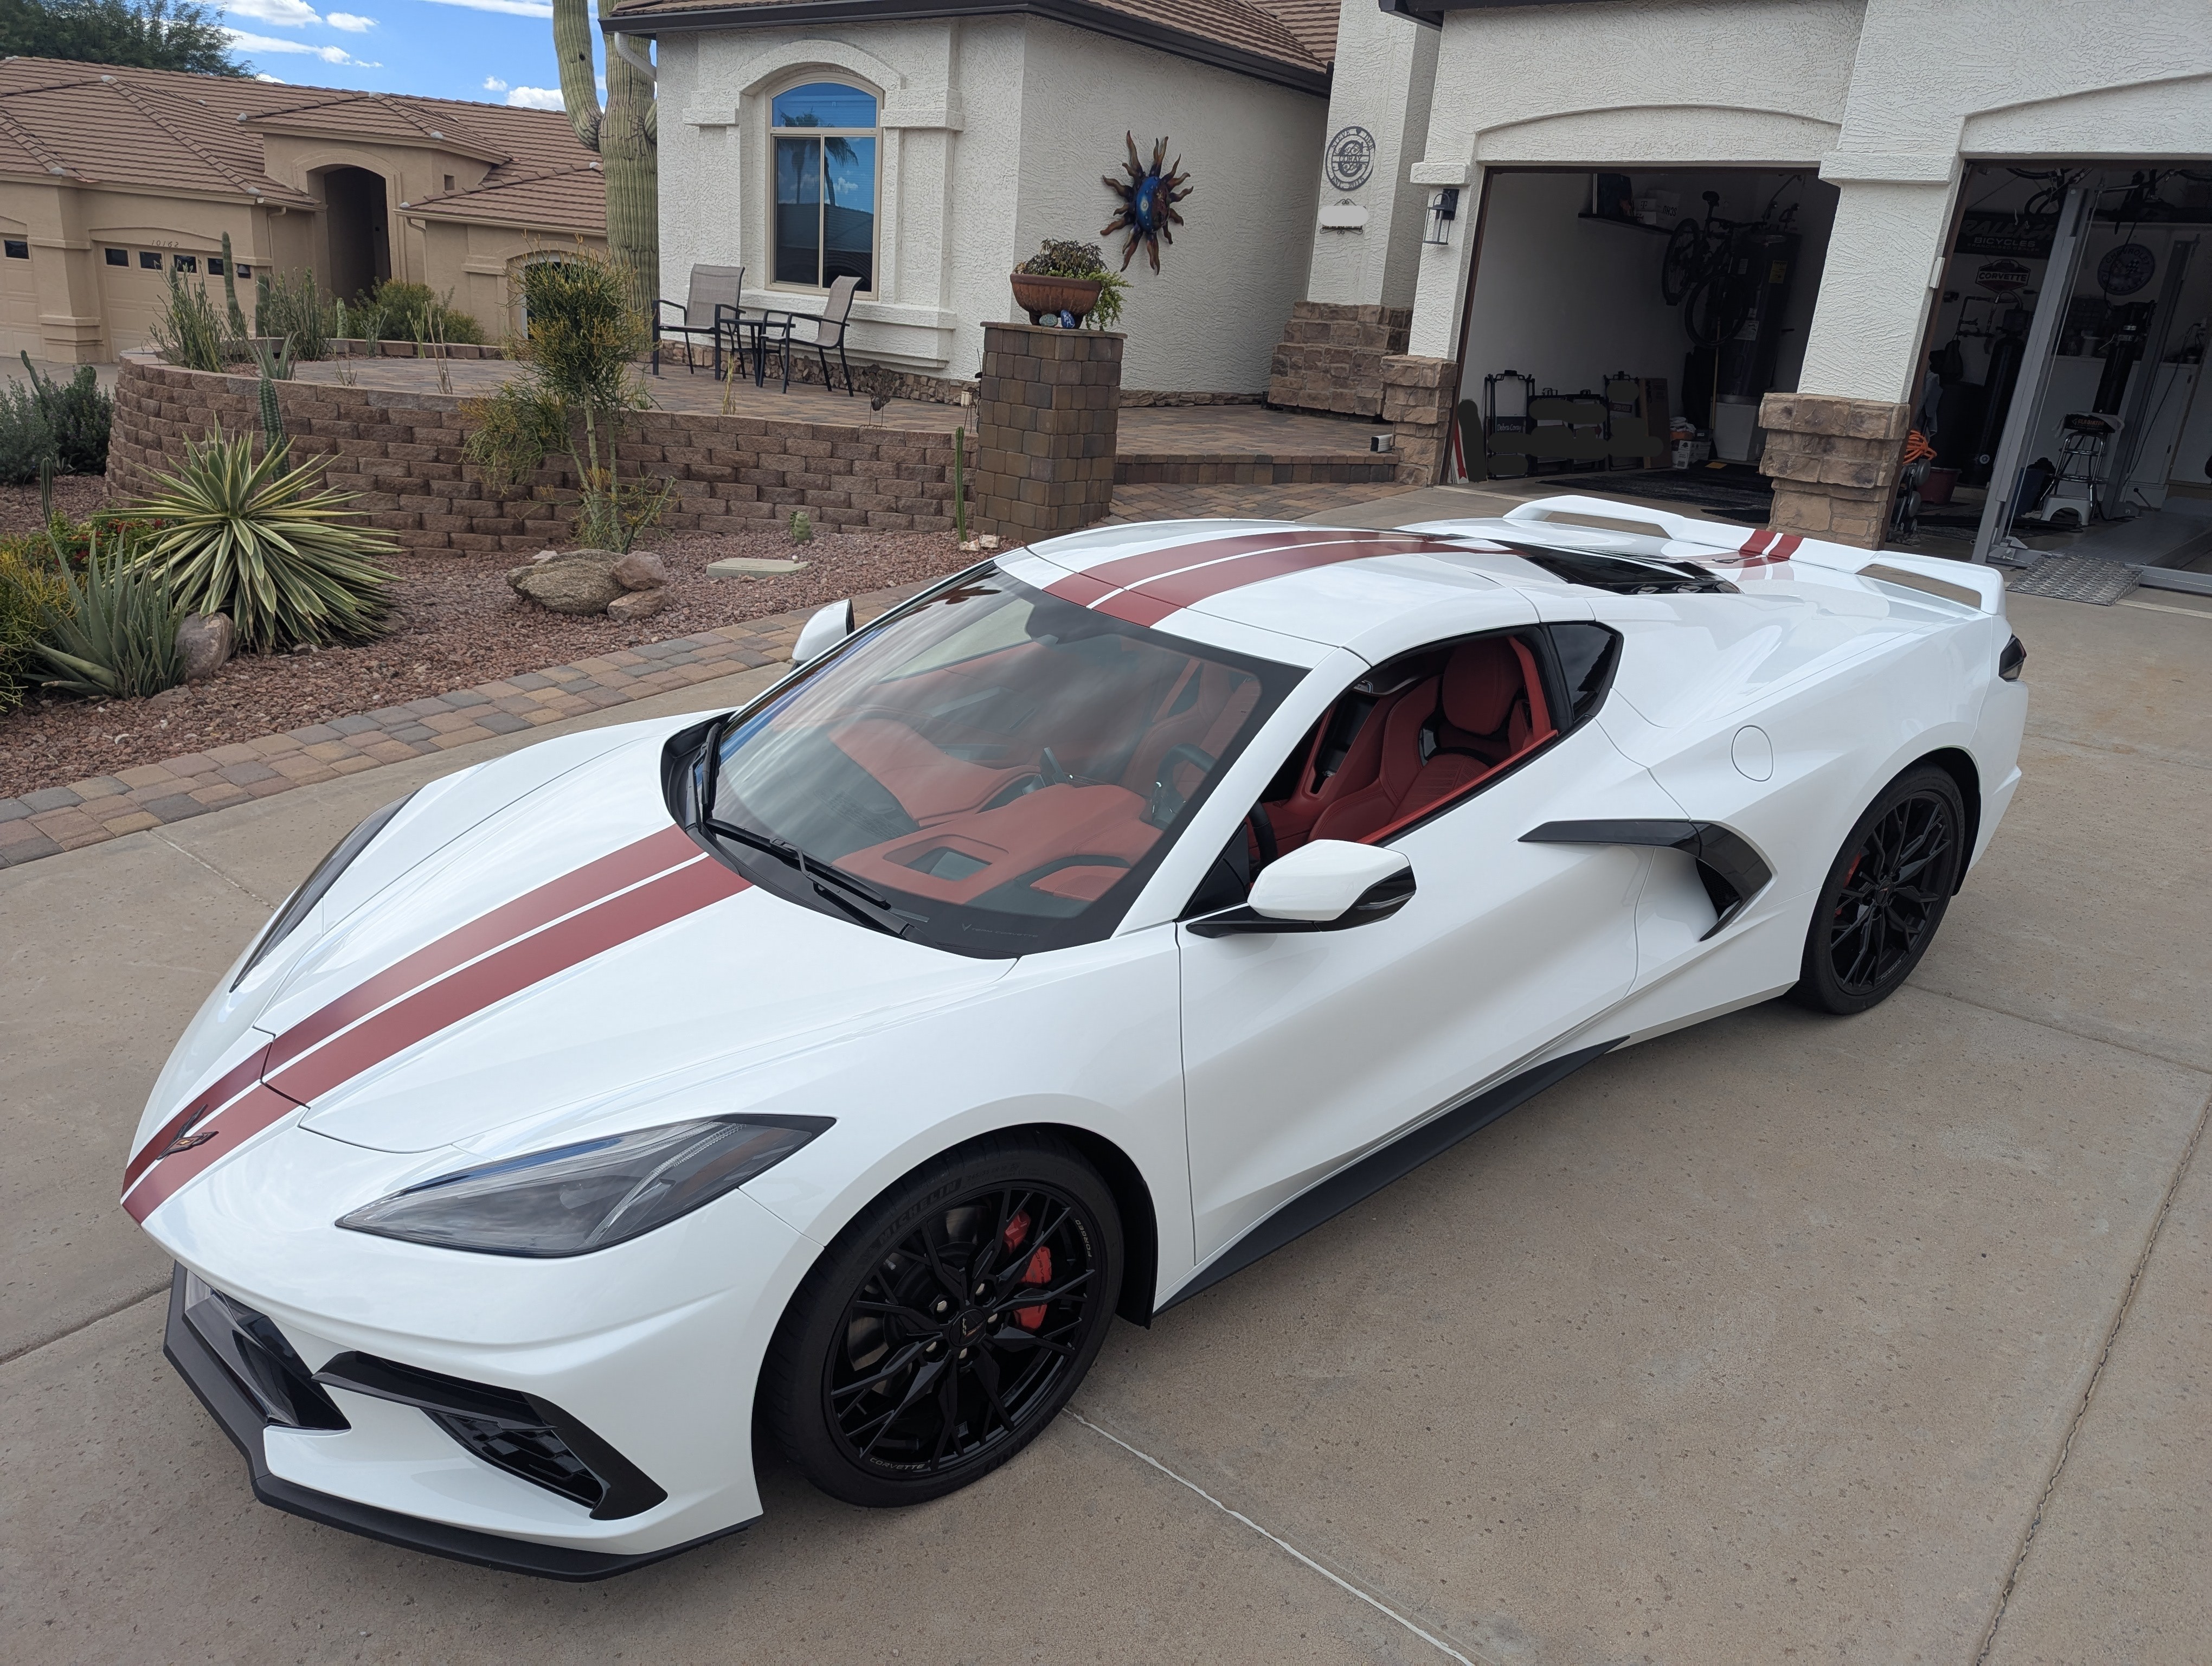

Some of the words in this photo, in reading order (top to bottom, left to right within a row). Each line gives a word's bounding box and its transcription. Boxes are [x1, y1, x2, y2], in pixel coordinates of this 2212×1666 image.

[1330, 130, 1350, 148] STEVE
[151, 240, 179, 248] 10162
[1974, 237, 2036, 247] BICYCLES
[1979, 272, 2027, 281] CORVETTE
[1497, 423, 1509, 431] Debra
[1510, 424, 1522, 433] Coray
[878, 1180, 957, 1245] MICHELIN
[1075, 1220, 1092, 1258] FORGED
[870, 1457, 925, 1470] CORVETTE
